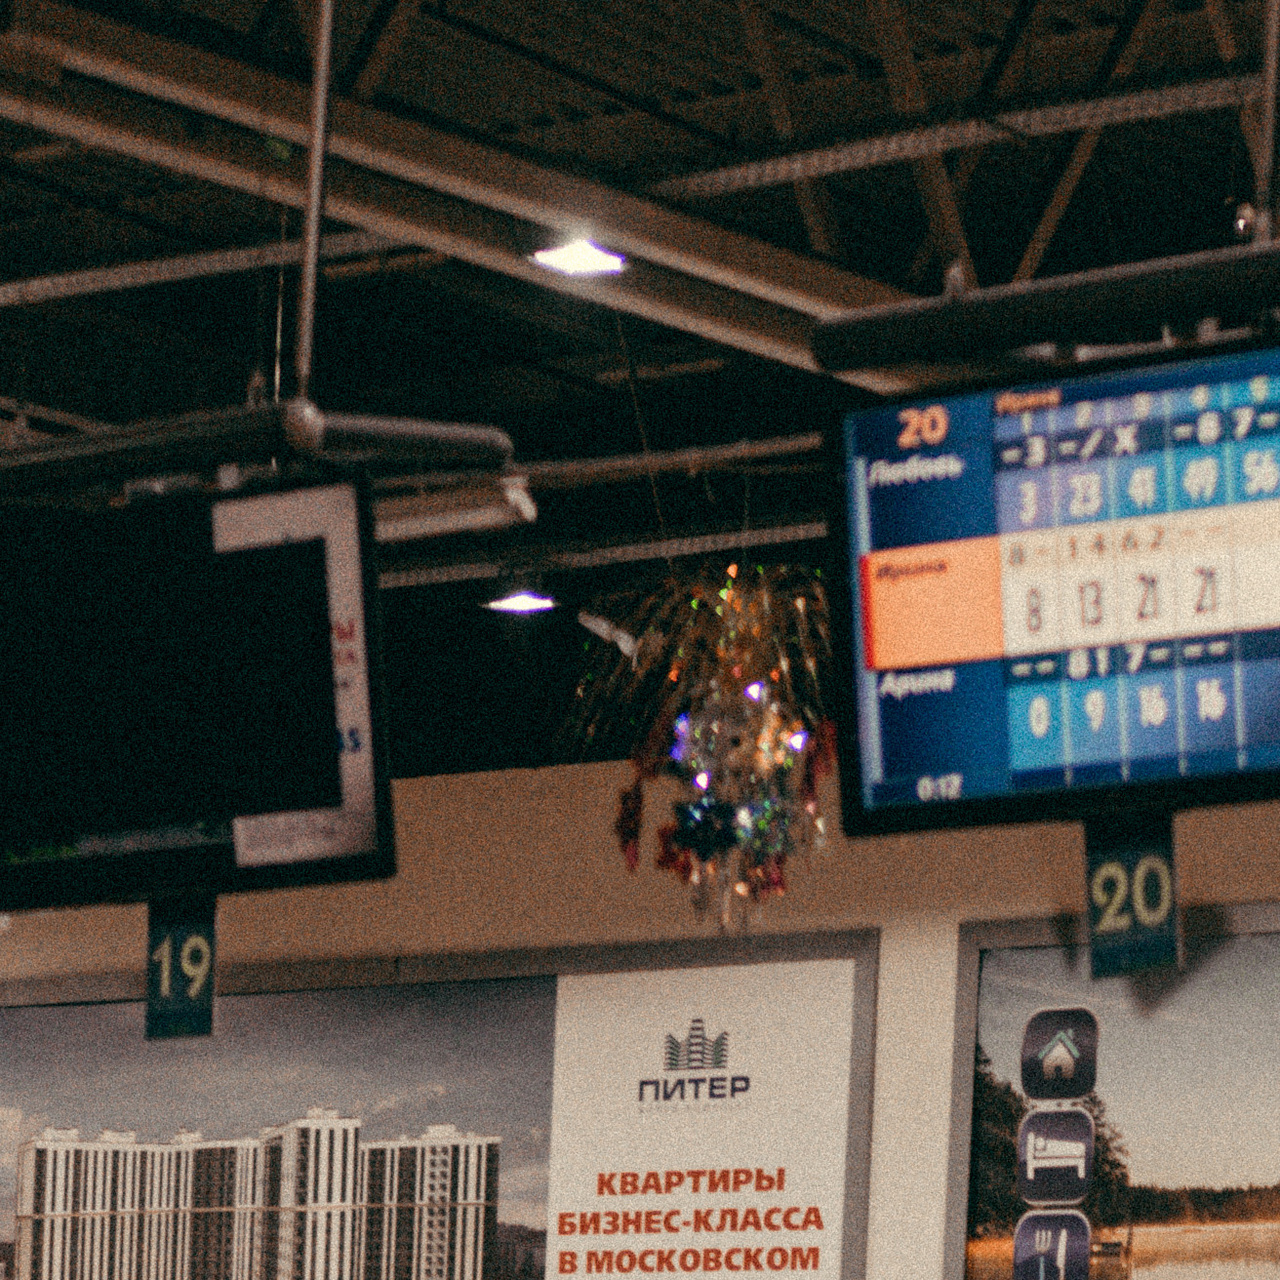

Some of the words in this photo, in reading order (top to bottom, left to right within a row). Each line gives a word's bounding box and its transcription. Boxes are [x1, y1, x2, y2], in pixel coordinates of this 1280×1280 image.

[897, 405, 949, 448] 20
[1018, 482, 1037, 523] 3
[1069, 472, 1103, 516] 23
[1242, 450, 1279, 493] 56
[1026, 586, 1042, 632] 8
[1078, 579, 1101, 628] 13
[1137, 573, 1159, 621] 21
[1195, 566, 1217, 614] 21
[1028, 696, 1050, 738] 0
[1085, 690, 1104, 731] 9
[1139, 684, 1167, 725] 16
[1197, 677, 1227, 720] 16
[1092, 855, 1171, 933] 20
[152, 935, 210, 998] 19
[638, 1076, 750, 1101] ПИТЕР
[597, 1167, 785, 1196] КВАРТИРЫ
[557, 1206, 824, 1236] БИЗНЕС-КЛАССА
[558, 1250, 577, 1274] В
[586, 1247, 819, 1274] МОСКОВСКОМ
